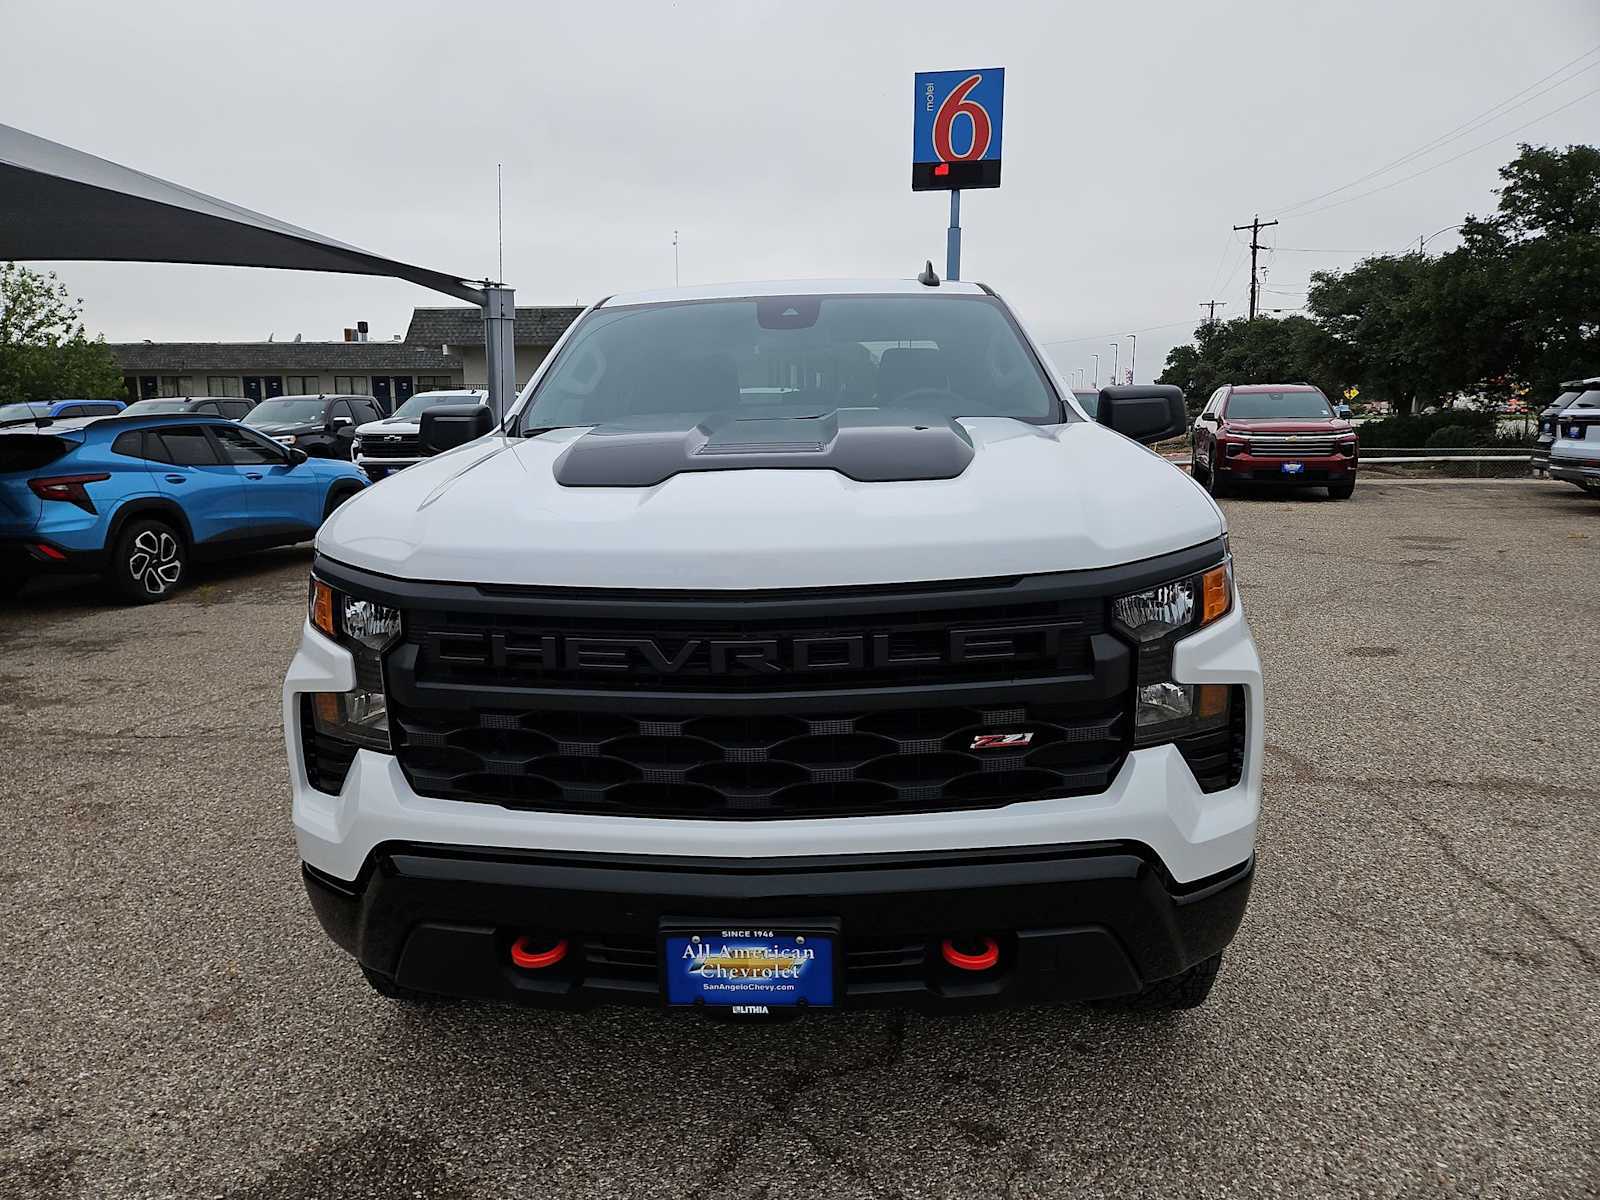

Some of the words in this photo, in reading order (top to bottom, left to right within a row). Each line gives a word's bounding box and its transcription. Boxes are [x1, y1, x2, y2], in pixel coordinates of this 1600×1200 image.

[925, 82, 935, 112] motel
[931, 74, 992, 162] 6
[424, 618, 1086, 675] CHEVROLET
[969, 732, 1034, 749] Z71
[721, 930, 751, 938] SINCE
[753, 930, 774, 938] 1946
[682, 943, 710, 960] All
[720, 944, 815, 960] American
[700, 963, 800, 979] Chevrolet
[703, 983, 795, 991] SanAngeloChevy.com
